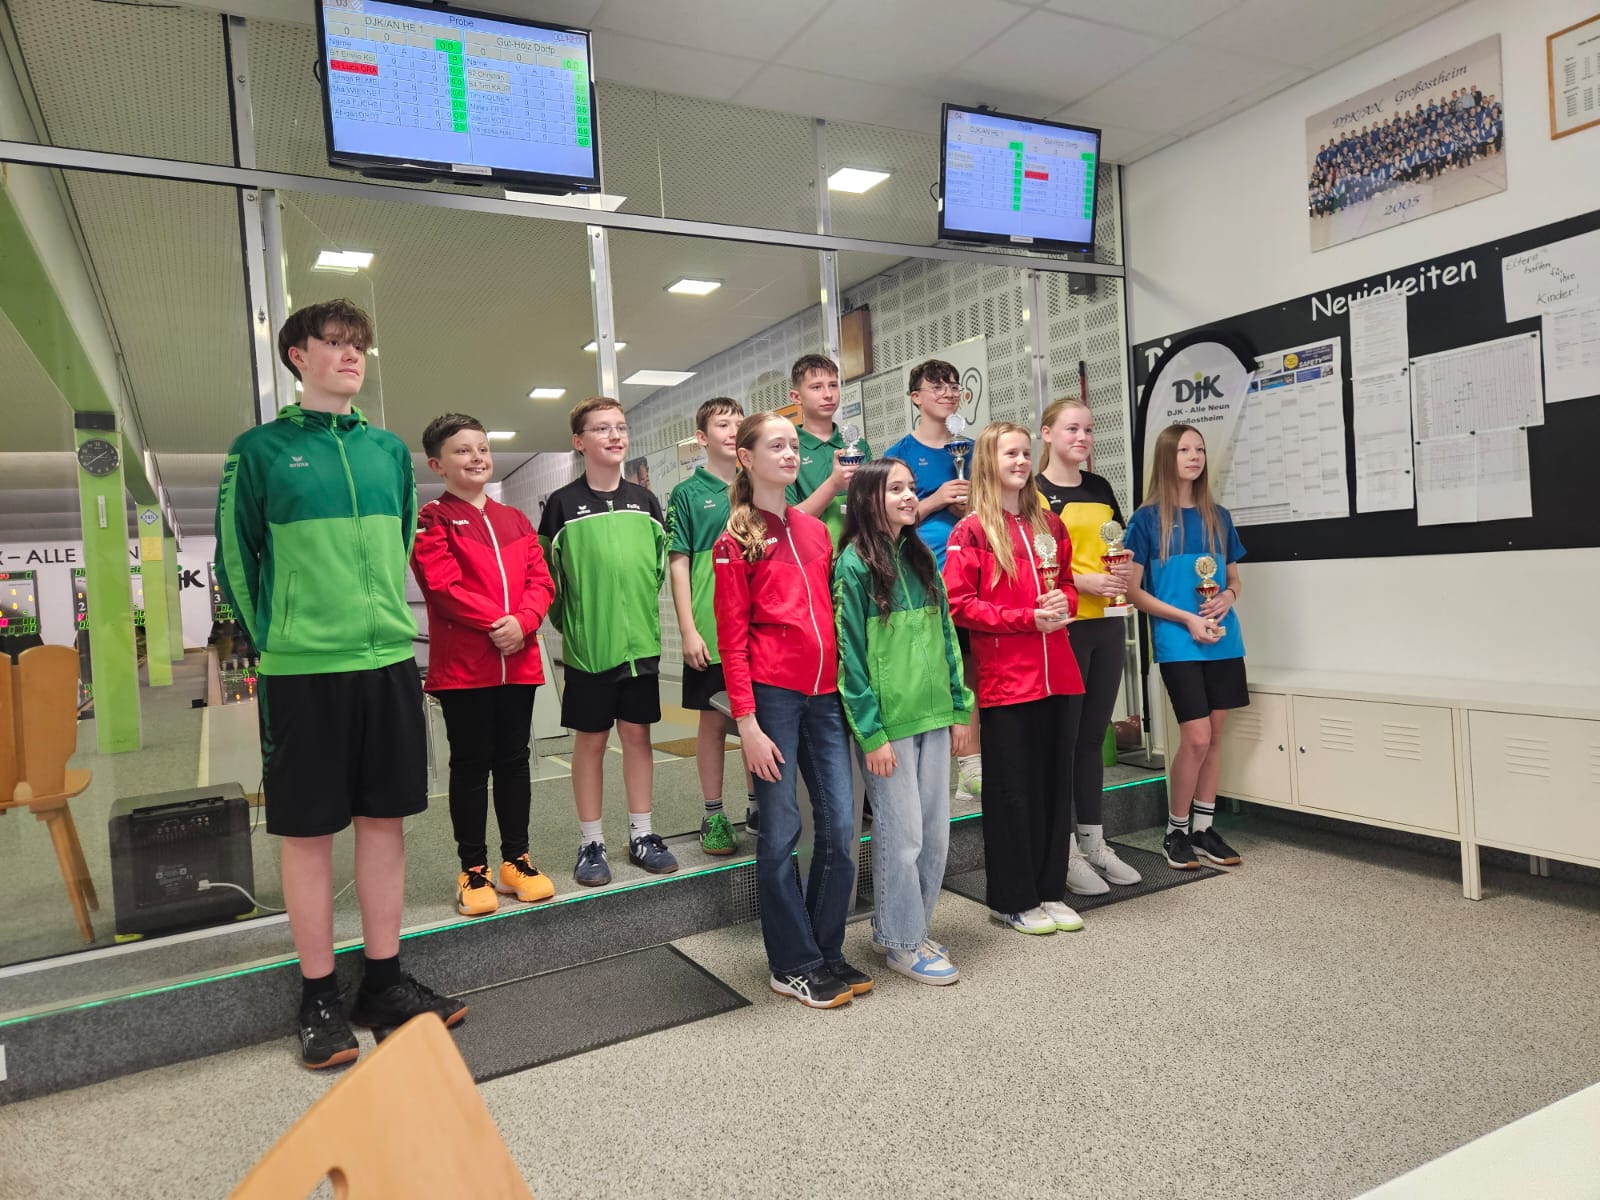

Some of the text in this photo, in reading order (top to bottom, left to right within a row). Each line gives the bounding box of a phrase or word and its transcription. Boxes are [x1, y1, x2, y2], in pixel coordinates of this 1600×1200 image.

[365, 16, 400, 31] DJK/AN
[449, 15, 474, 28] Probe
[1167, 409, 1184, 417] DJK
[1190, 405, 1206, 413] Alle
[1208, 403, 1230, 411] Neun
[26, 548, 77, 564] ALLE
[214, 593, 222, 603] 3
[78, 601, 87, 611] 2
